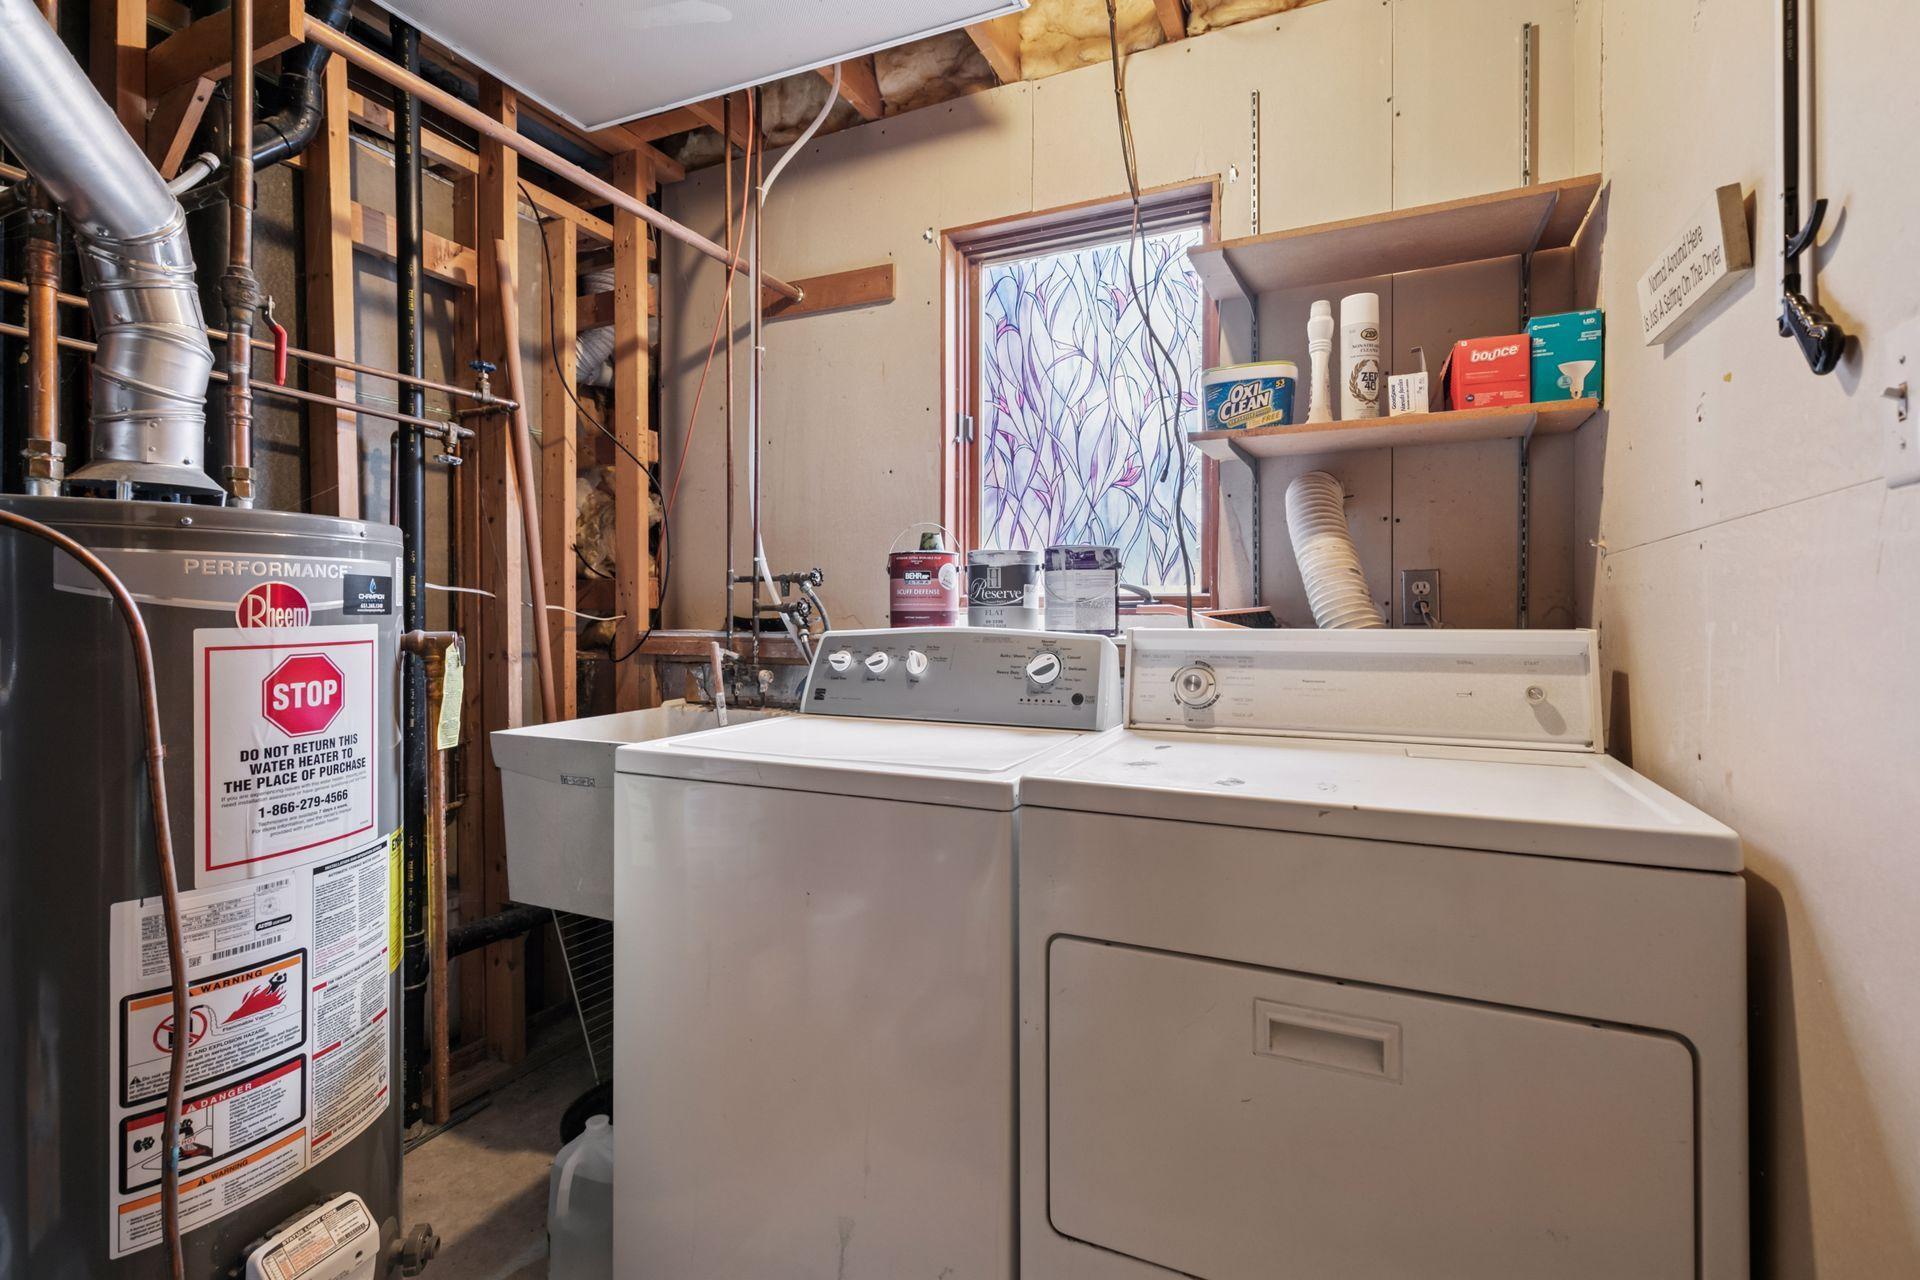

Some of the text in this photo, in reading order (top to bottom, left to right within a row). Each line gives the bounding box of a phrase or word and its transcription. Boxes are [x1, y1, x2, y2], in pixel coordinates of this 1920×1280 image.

[1648, 225, 1703, 295] Normal Around Here
[1664, 285, 1683, 314] Setting
[1682, 276, 1692, 296] On
[1690, 263, 1703, 287] The
[1470, 344, 1519, 363] bounce
[1230, 382, 1260, 404] OXI
[1364, 382, 1376, 390] 40
[1220, 391, 1270, 421] CLEAN
[184, 558, 348, 580] PERFORMANCE
[905, 572, 922, 580] BEHR
[970, 578, 1022, 600] Reserve
[247, 583, 306, 628] Rheem
[272, 680, 338, 711] STOP
[240, 734, 358, 762] DO NOT RETURN THIS
[224, 757, 366, 794] THE PLACE OF PURCHASE
[250, 748, 353, 776] WATER HEATER TO
[258, 788, 348, 818] 1-866-279-4566
[200, 969, 264, 993] WARNING
[222, 1012, 274, 1032] Flammable Vapors
[194, 1046, 208, 1056] AND
[208, 1036, 242, 1050] EXPLOSION
[244, 1027, 266, 1039] HAZARD
[200, 1083, 252, 1109] DANGER
[210, 1158, 248, 1180] WARNING
